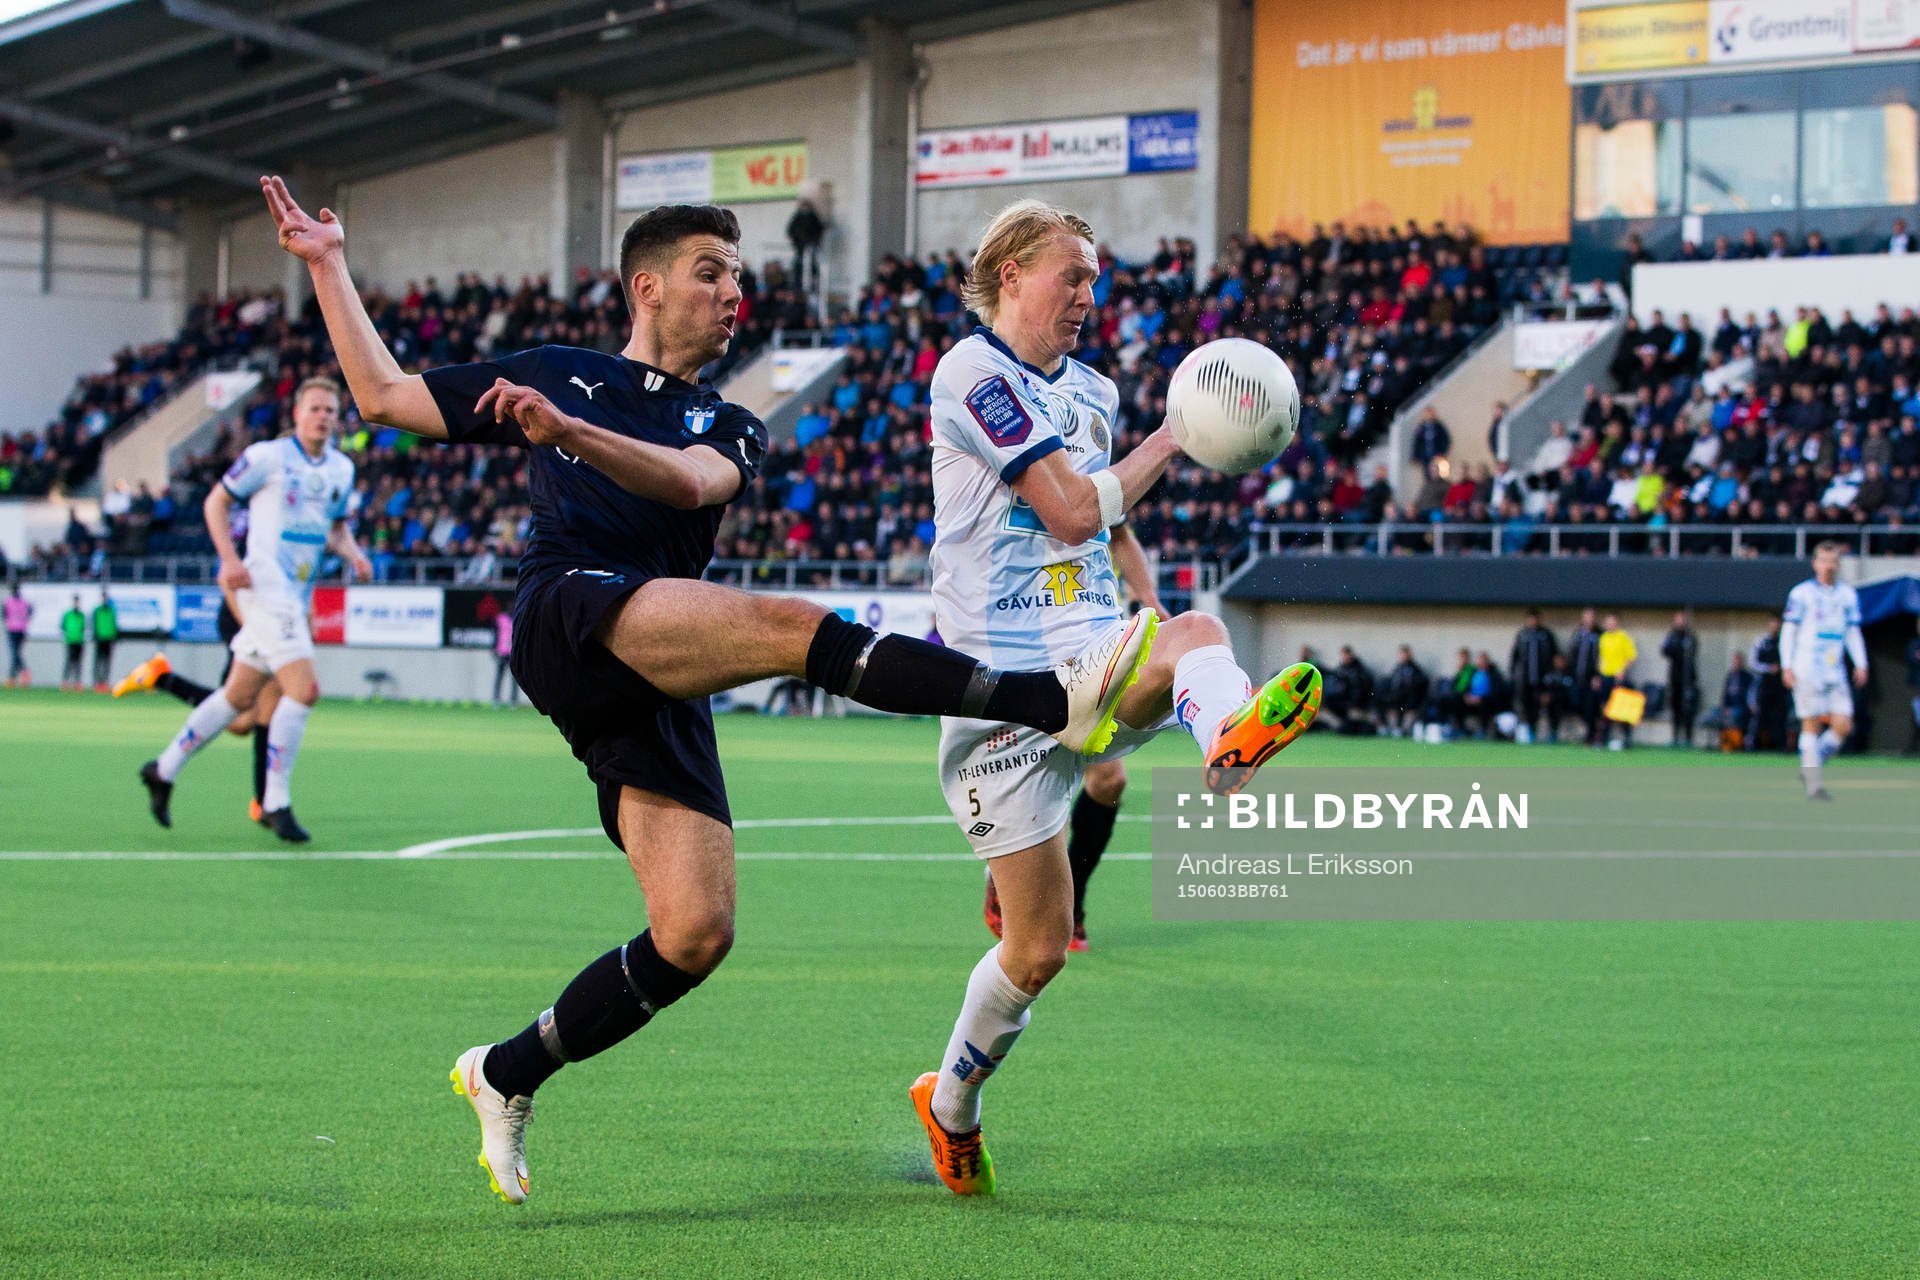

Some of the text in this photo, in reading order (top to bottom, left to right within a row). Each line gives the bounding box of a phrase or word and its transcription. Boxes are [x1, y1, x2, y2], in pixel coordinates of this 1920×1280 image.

[1749, 9, 1850, 41] Grontmij
[1383, 38, 1428, 61] som
[980, 394, 1010, 417] SVERIGES
[982, 392, 999, 406] HELA
[983, 400, 1014, 424] FOTBOLLS
[993, 410, 1014, 426] KLUBB
[1065, 443, 1085, 454] etro
[996, 594, 1053, 611] GÄVLE
[968, 787, 982, 817] 5
